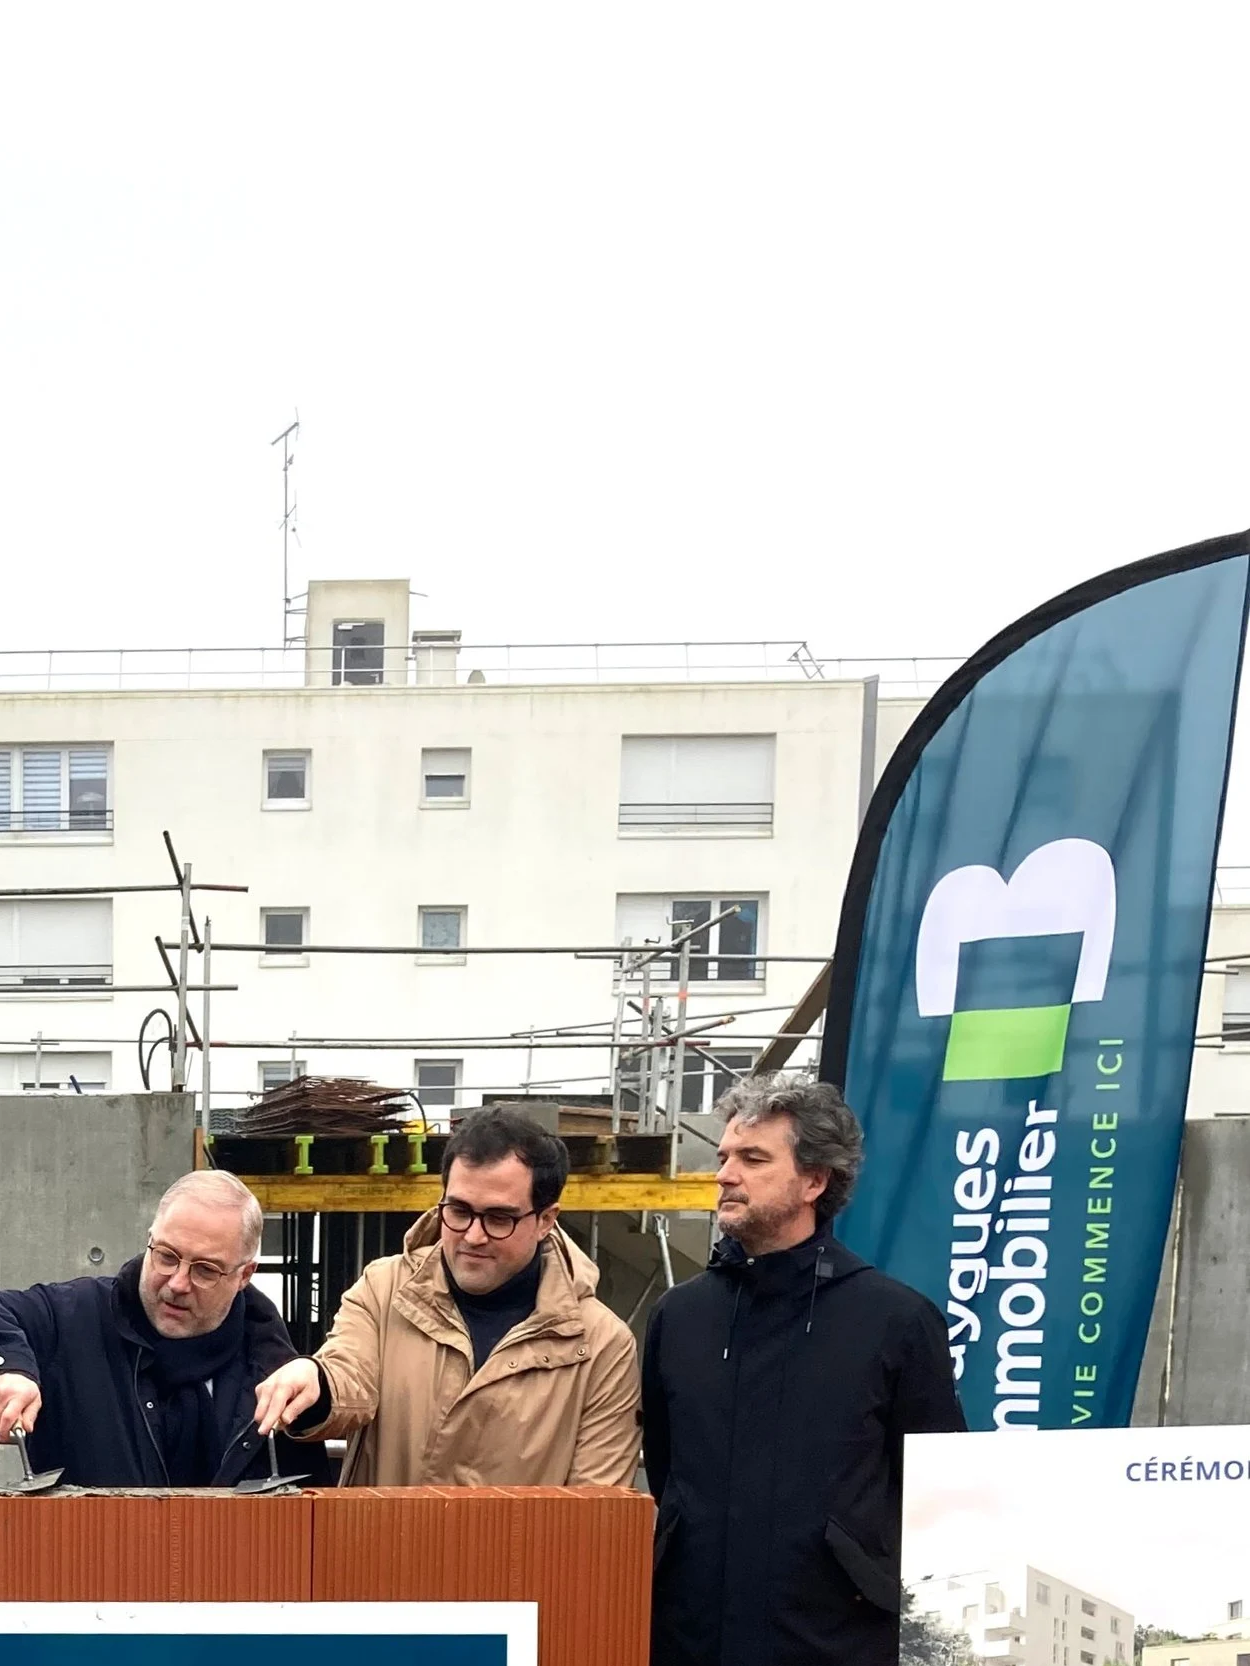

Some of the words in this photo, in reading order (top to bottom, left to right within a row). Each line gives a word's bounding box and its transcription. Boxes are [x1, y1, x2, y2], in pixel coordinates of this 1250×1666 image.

[1095, 1039, 1124, 1090] ICI
[1079, 1112, 1118, 1343] COMMENCE
[1071, 1364, 1097, 1424] VIE
[1126, 1456, 1250, 1481] CÉRÉMO
